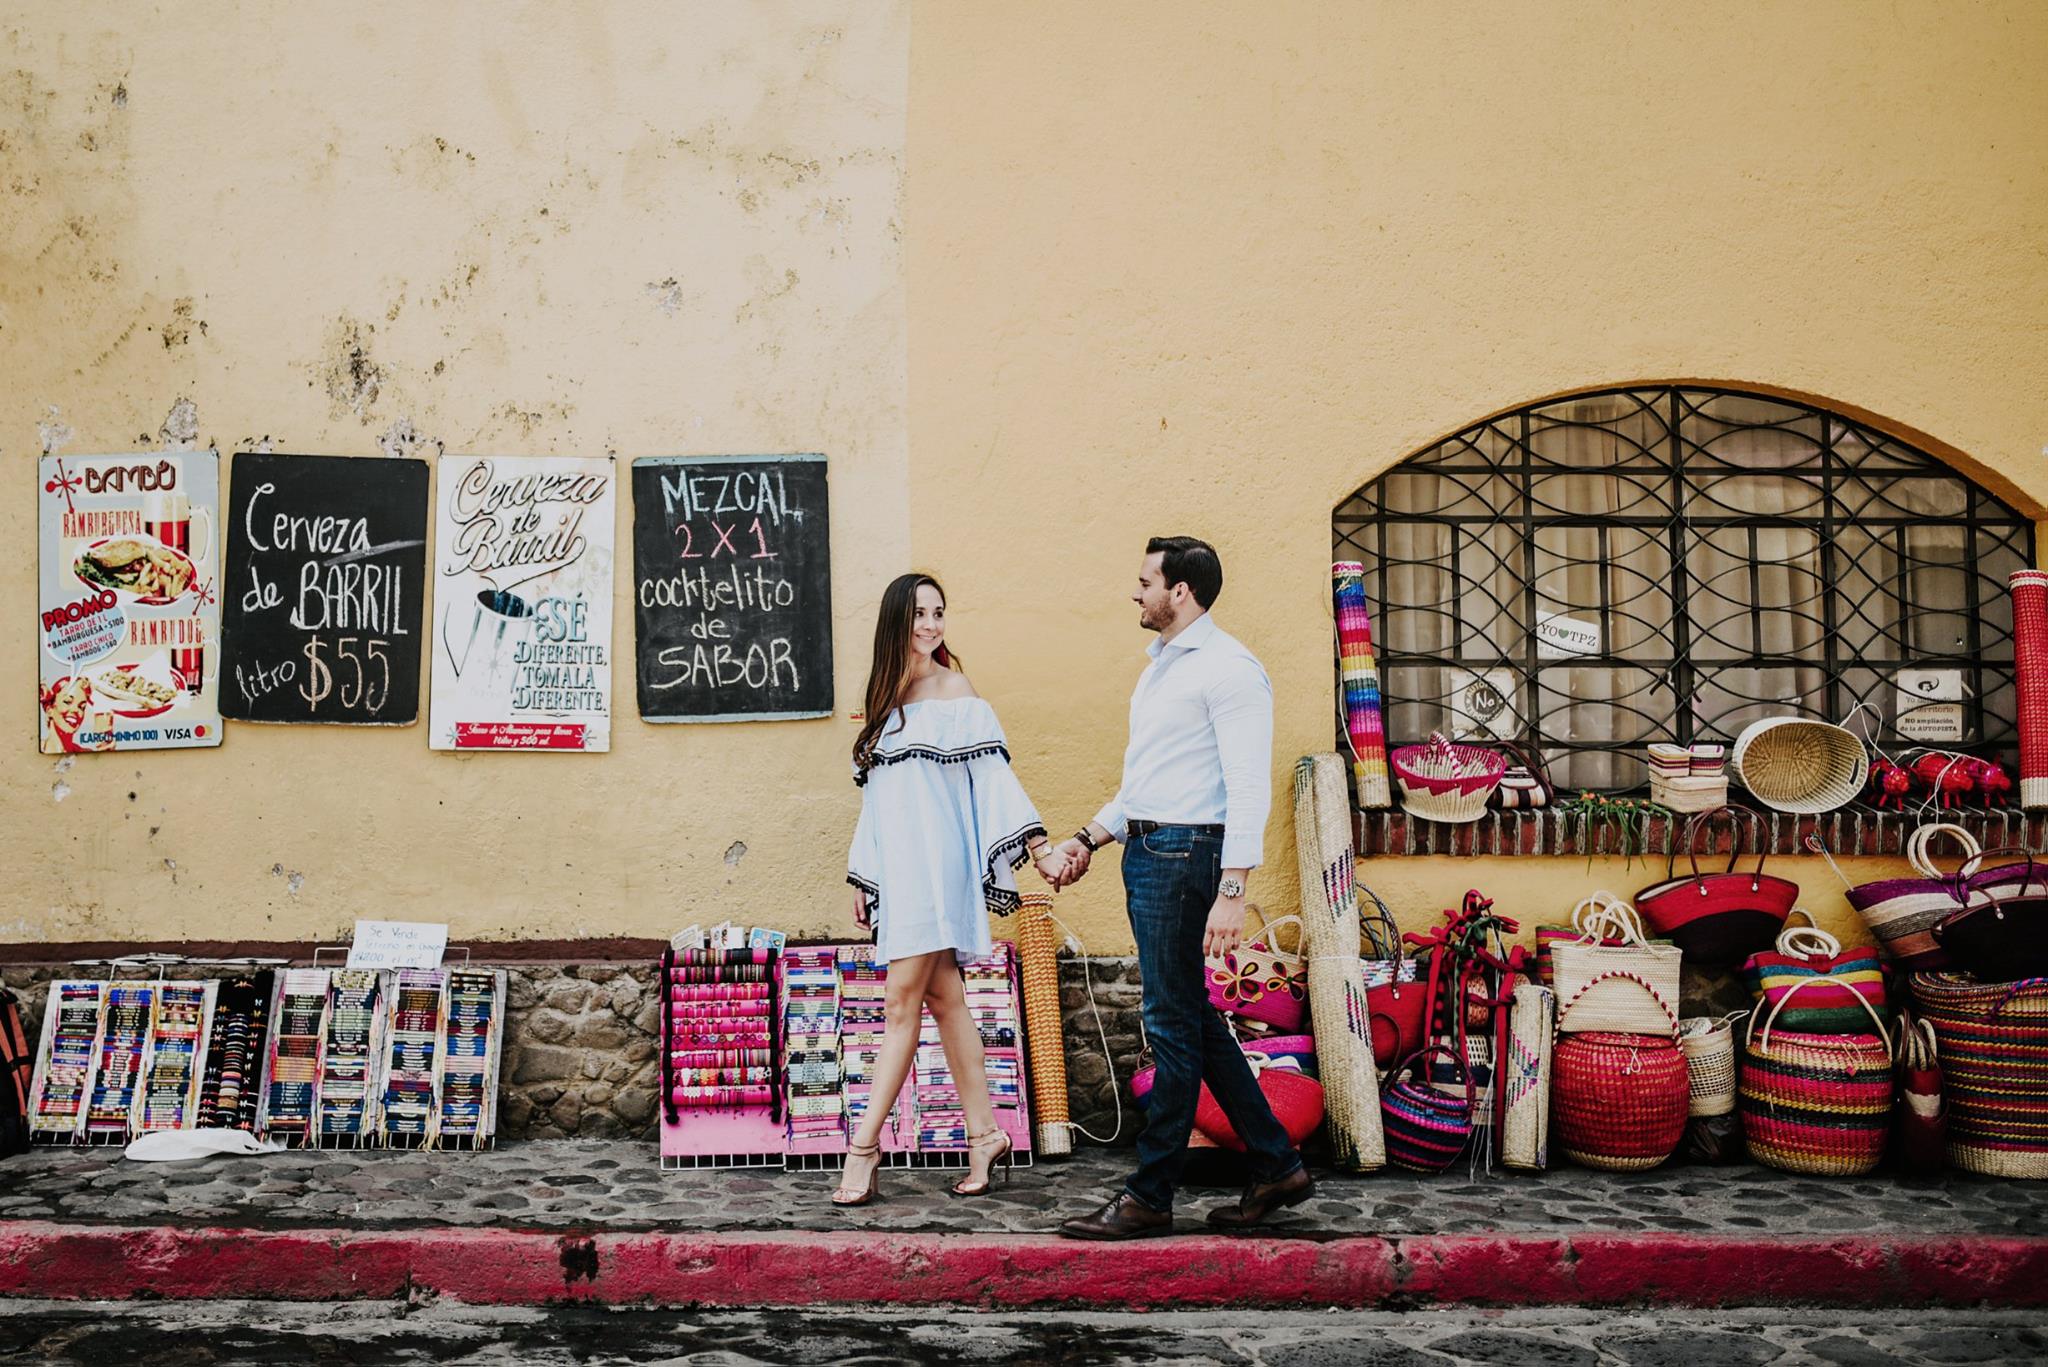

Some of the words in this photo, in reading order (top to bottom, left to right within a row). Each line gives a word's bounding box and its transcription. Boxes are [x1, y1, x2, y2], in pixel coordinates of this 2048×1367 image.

[450, 459, 608, 525] Cerveza
[660, 469, 804, 526] MEZCAL
[63, 510, 141, 538] BAMBURGUESA
[246, 482, 372, 554] Cerveza
[510, 502, 542, 536] de
[442, 507, 587, 577] Barril
[674, 523, 703, 558] 2
[748, 517, 779, 560] 1
[242, 566, 284, 613] de
[289, 560, 409, 635] BARRIL
[640, 564, 794, 612] cocktelito
[41, 589, 117, 632] PROMO
[60, 621, 85, 638] TARRO
[87, 618, 97, 627] DE
[691, 612, 731, 639] de
[70, 640, 93, 654] TARRO
[513, 641, 608, 667] DIFERENTE,
[1540, 622, 1559, 638] YO
[1569, 630, 1597, 648] TPZ
[236, 660, 296, 701] litro
[299, 634, 391, 715] $55
[650, 638, 800, 692] SABOR
[512, 687, 607, 712] DIFERENTE.
[1475, 690, 1495, 711] No
[164, 728, 192, 741] VISA
